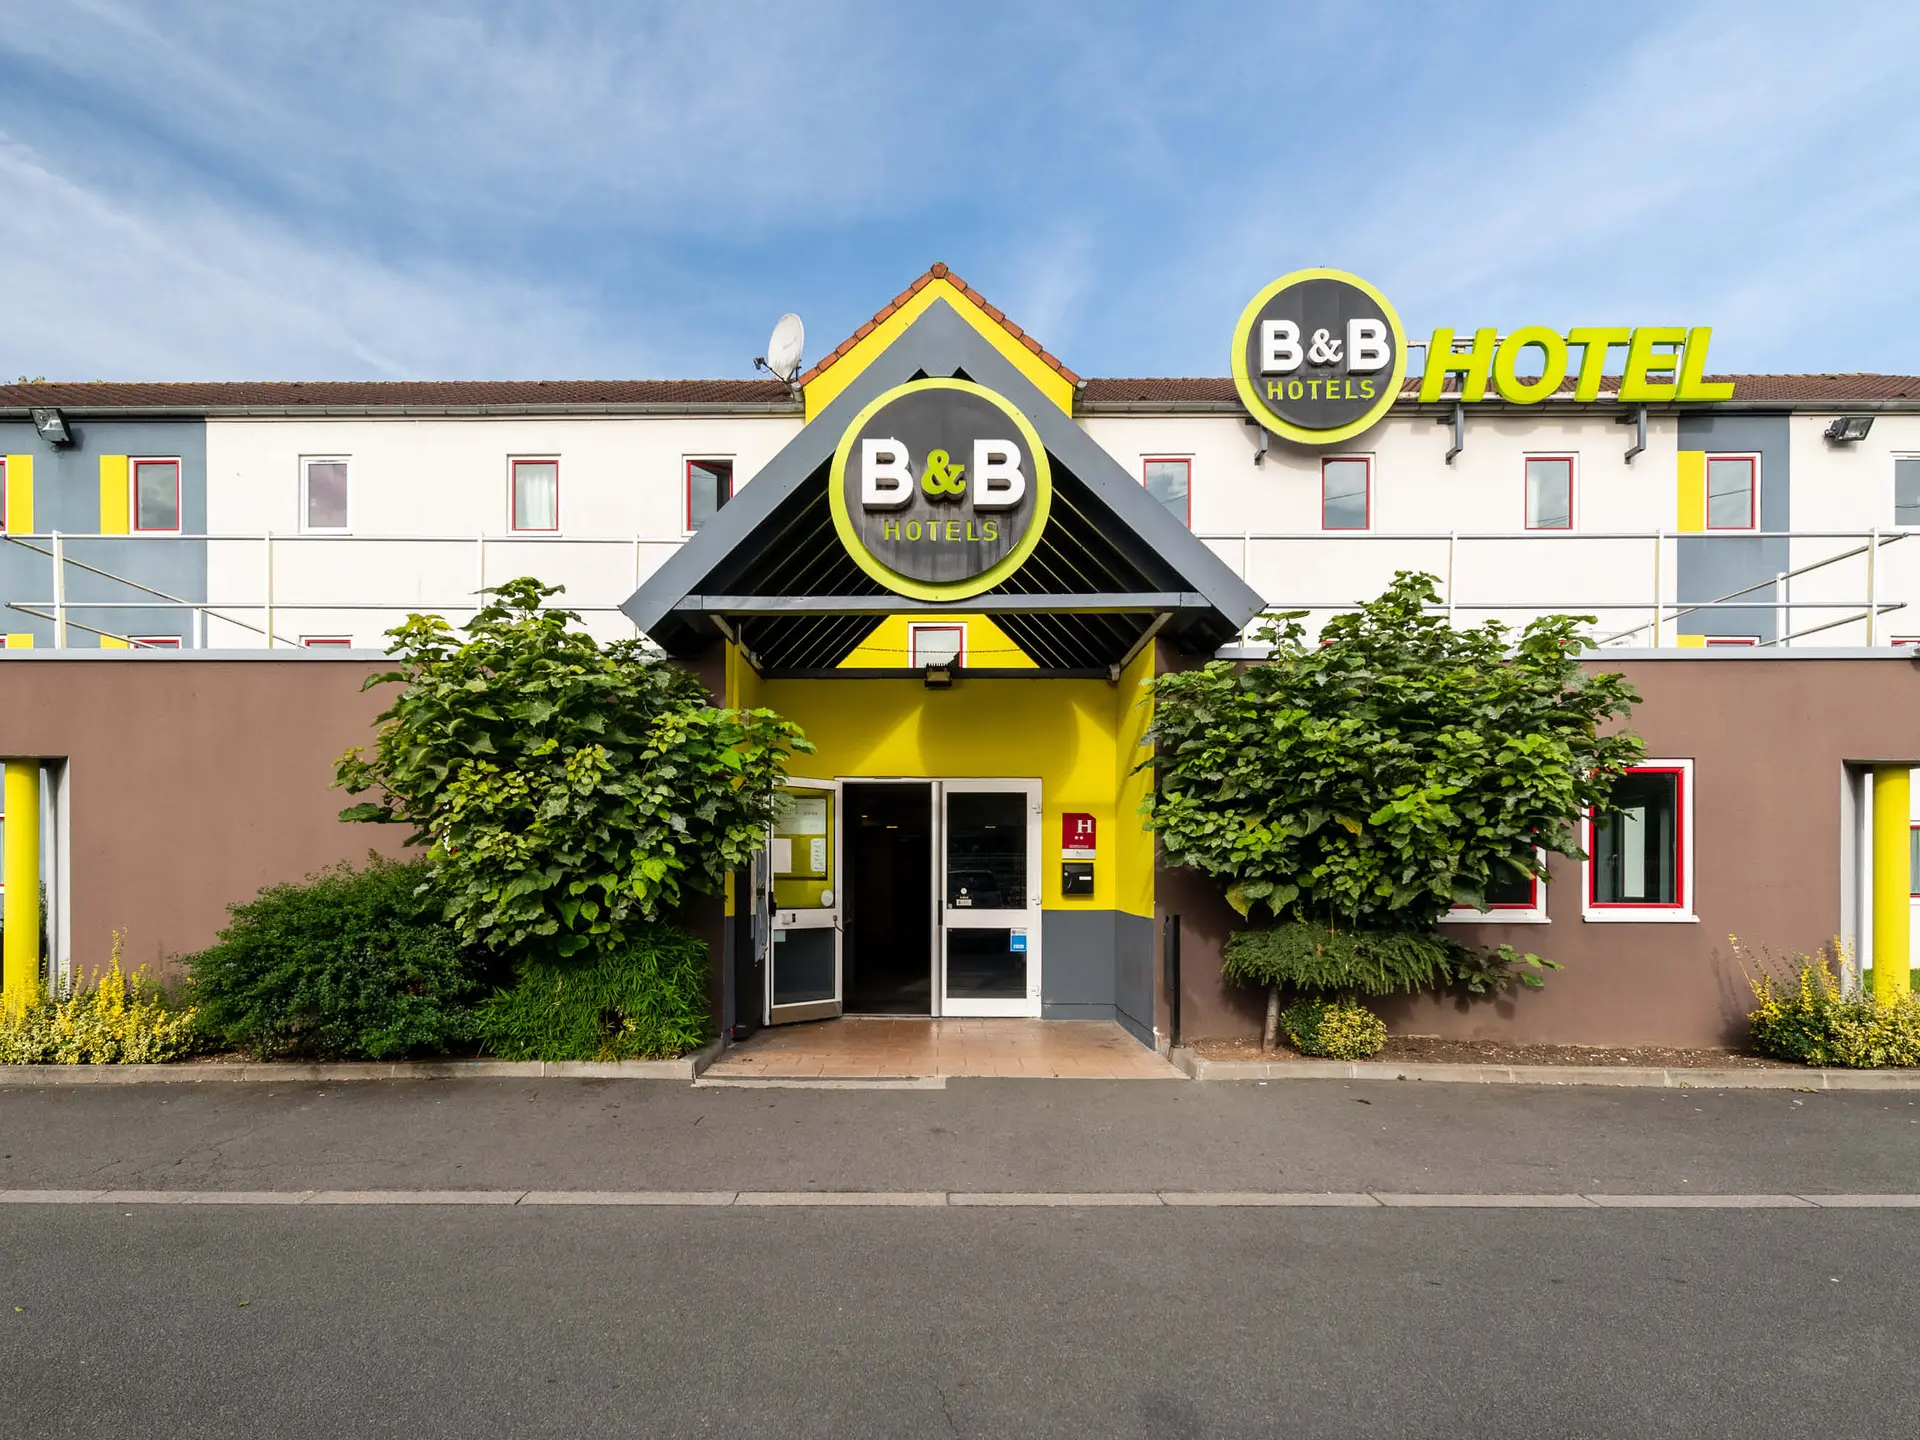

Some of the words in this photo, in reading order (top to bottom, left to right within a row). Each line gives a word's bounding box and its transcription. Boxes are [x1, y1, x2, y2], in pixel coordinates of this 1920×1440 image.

[1261, 319, 1391, 374] B&B
[1418, 326, 1735, 404] HOTEL
[1267, 379, 1376, 400] HOTELS
[862, 437, 1026, 509] B&B
[883, 519, 999, 542] HOTELS
[1076, 819, 1093, 834] H
